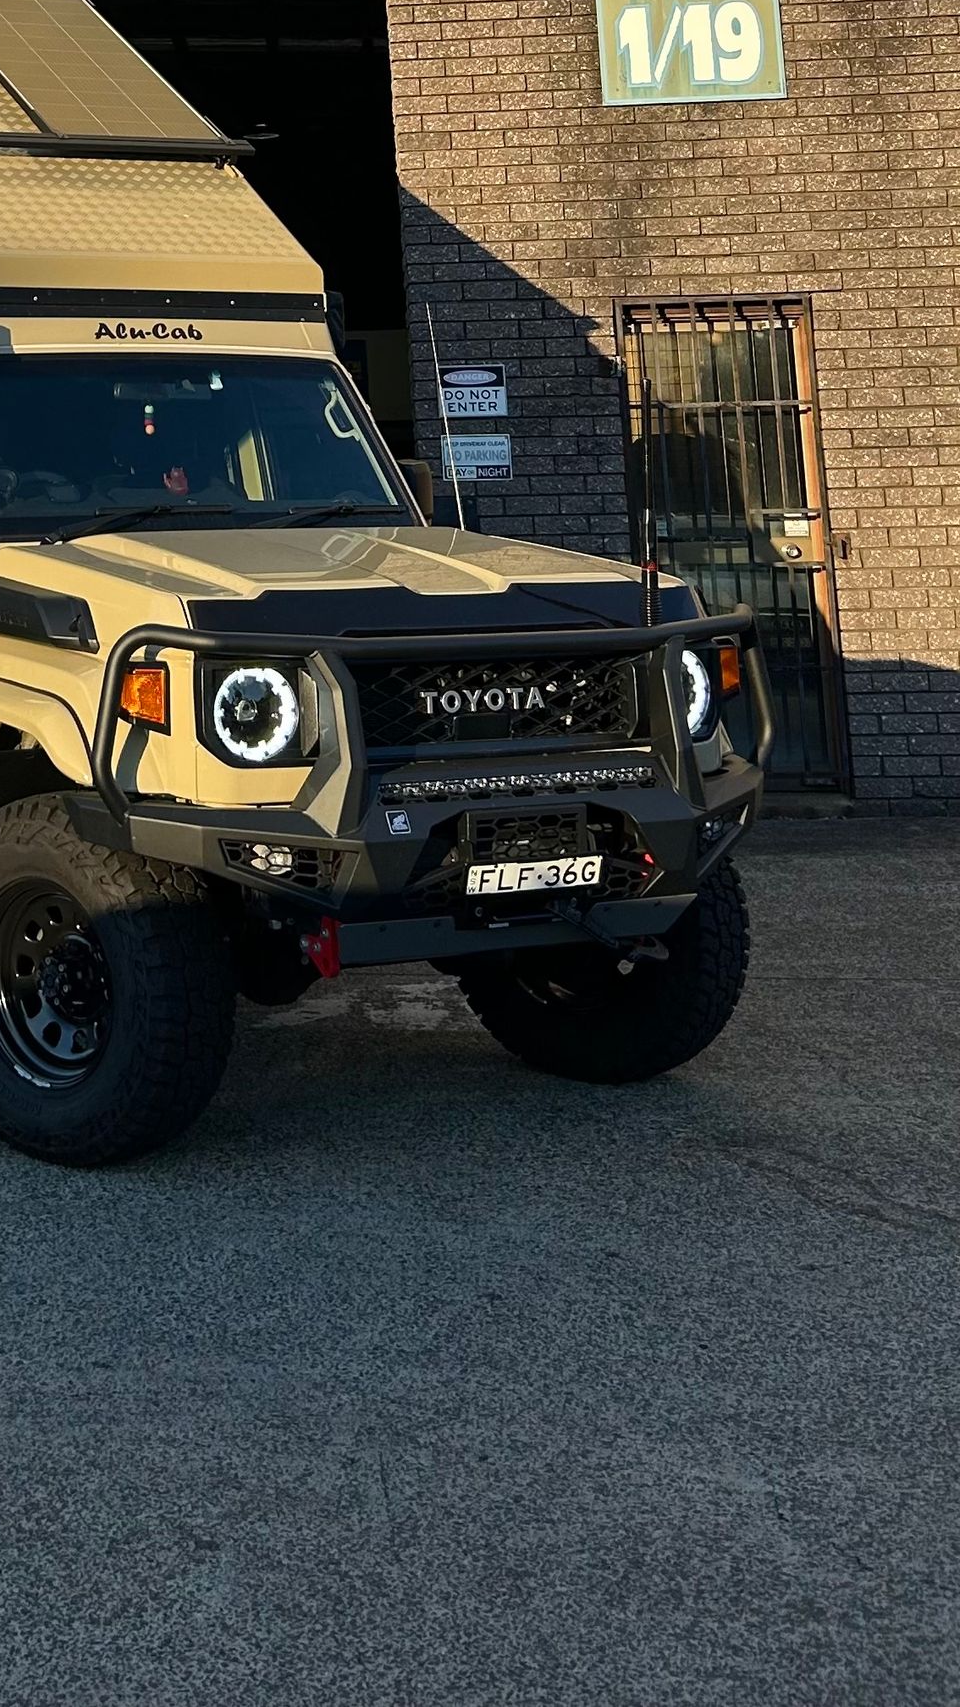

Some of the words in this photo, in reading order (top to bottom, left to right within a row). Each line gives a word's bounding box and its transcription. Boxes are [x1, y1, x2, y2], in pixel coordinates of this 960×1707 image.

[617, 0, 762, 86] 1/19
[94, 322, 203, 341] Alu-Cab
[444, 390, 465, 400] DO
[470, 389, 500, 400] NOT
[447, 402, 498, 412] ENTER
[464, 449, 507, 462] PARKING
[477, 467, 509, 477] NIGHT
[419, 686, 546, 715] TOYOTA
